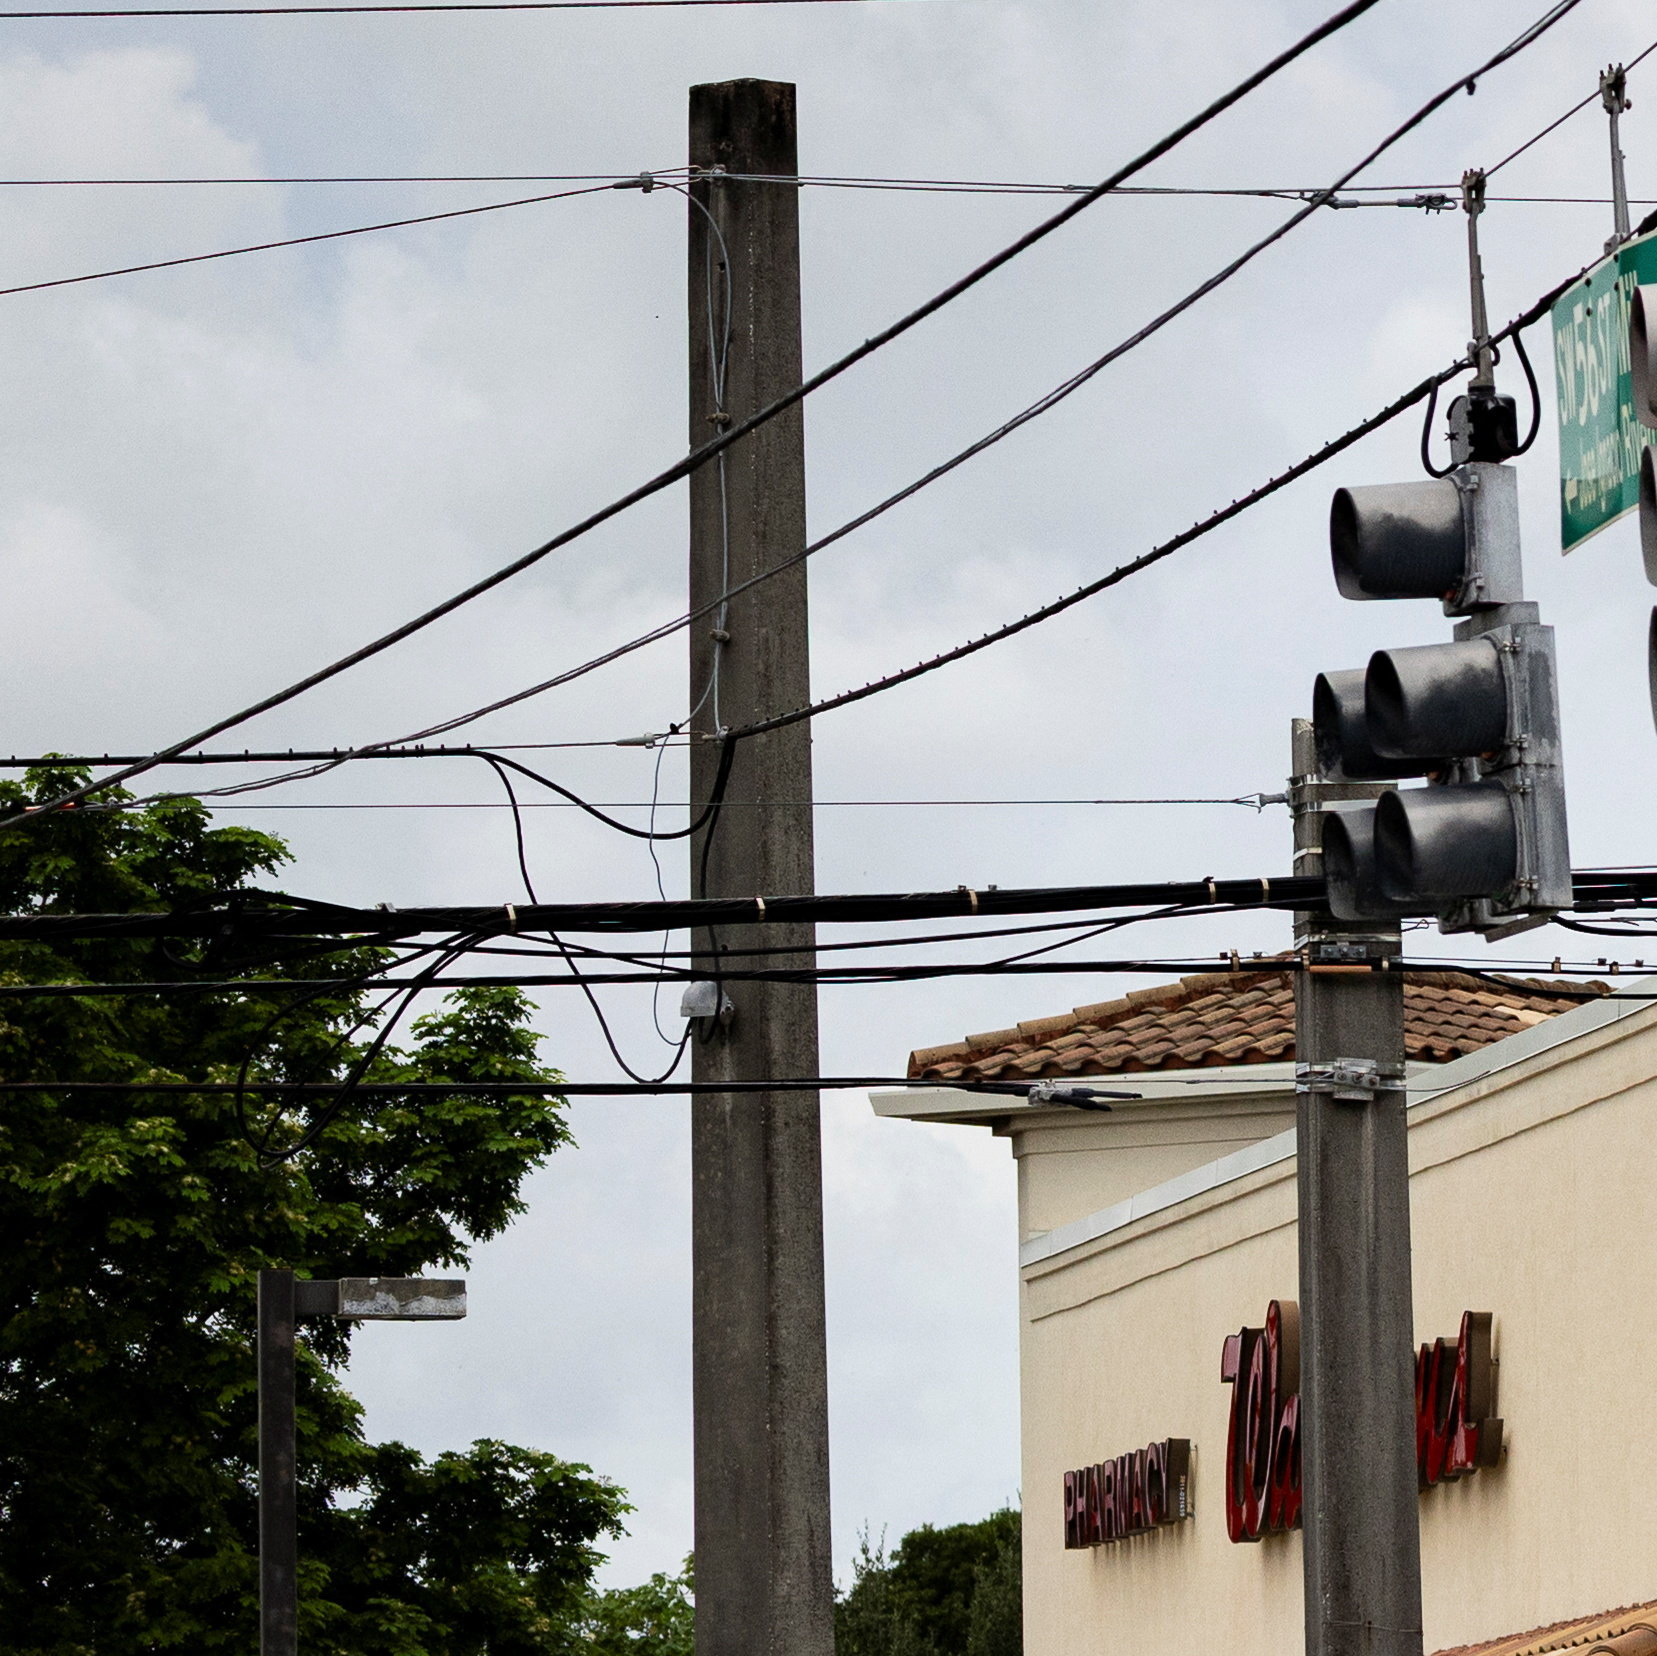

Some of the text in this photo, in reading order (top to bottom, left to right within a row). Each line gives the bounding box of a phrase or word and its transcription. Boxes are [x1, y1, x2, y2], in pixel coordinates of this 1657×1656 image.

[1556, 322, 1577, 425] SW
[1573, 298, 1599, 427] 56
[1596, 291, 1613, 395] ST
[1064, 1438, 1182, 1549] PHARMACY
